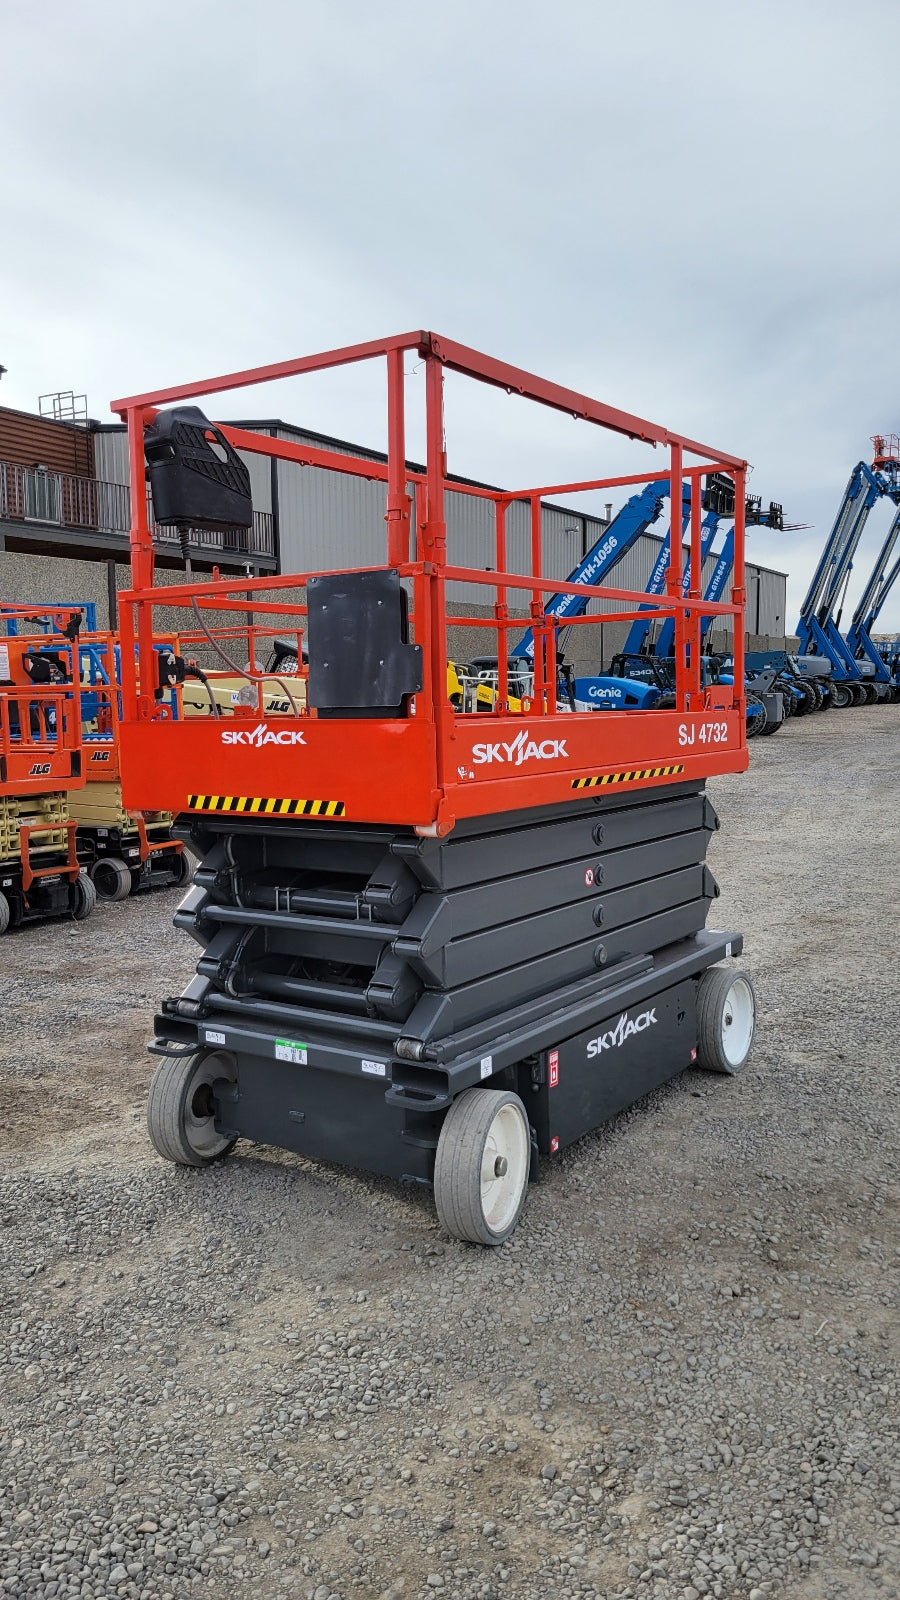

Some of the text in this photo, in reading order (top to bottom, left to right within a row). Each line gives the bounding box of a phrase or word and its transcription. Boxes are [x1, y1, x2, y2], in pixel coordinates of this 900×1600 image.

[588, 686, 622, 697] Genie
[266, 701, 290, 712] JLG
[221, 724, 307, 747] SKYJACK
[678, 722, 728, 745] SJ 4732
[91, 751, 110, 761] JLG
[472, 730, 569, 765] SKYJACK
[29, 763, 51, 775] JLG
[587, 1008, 658, 1058] SKYJACK
